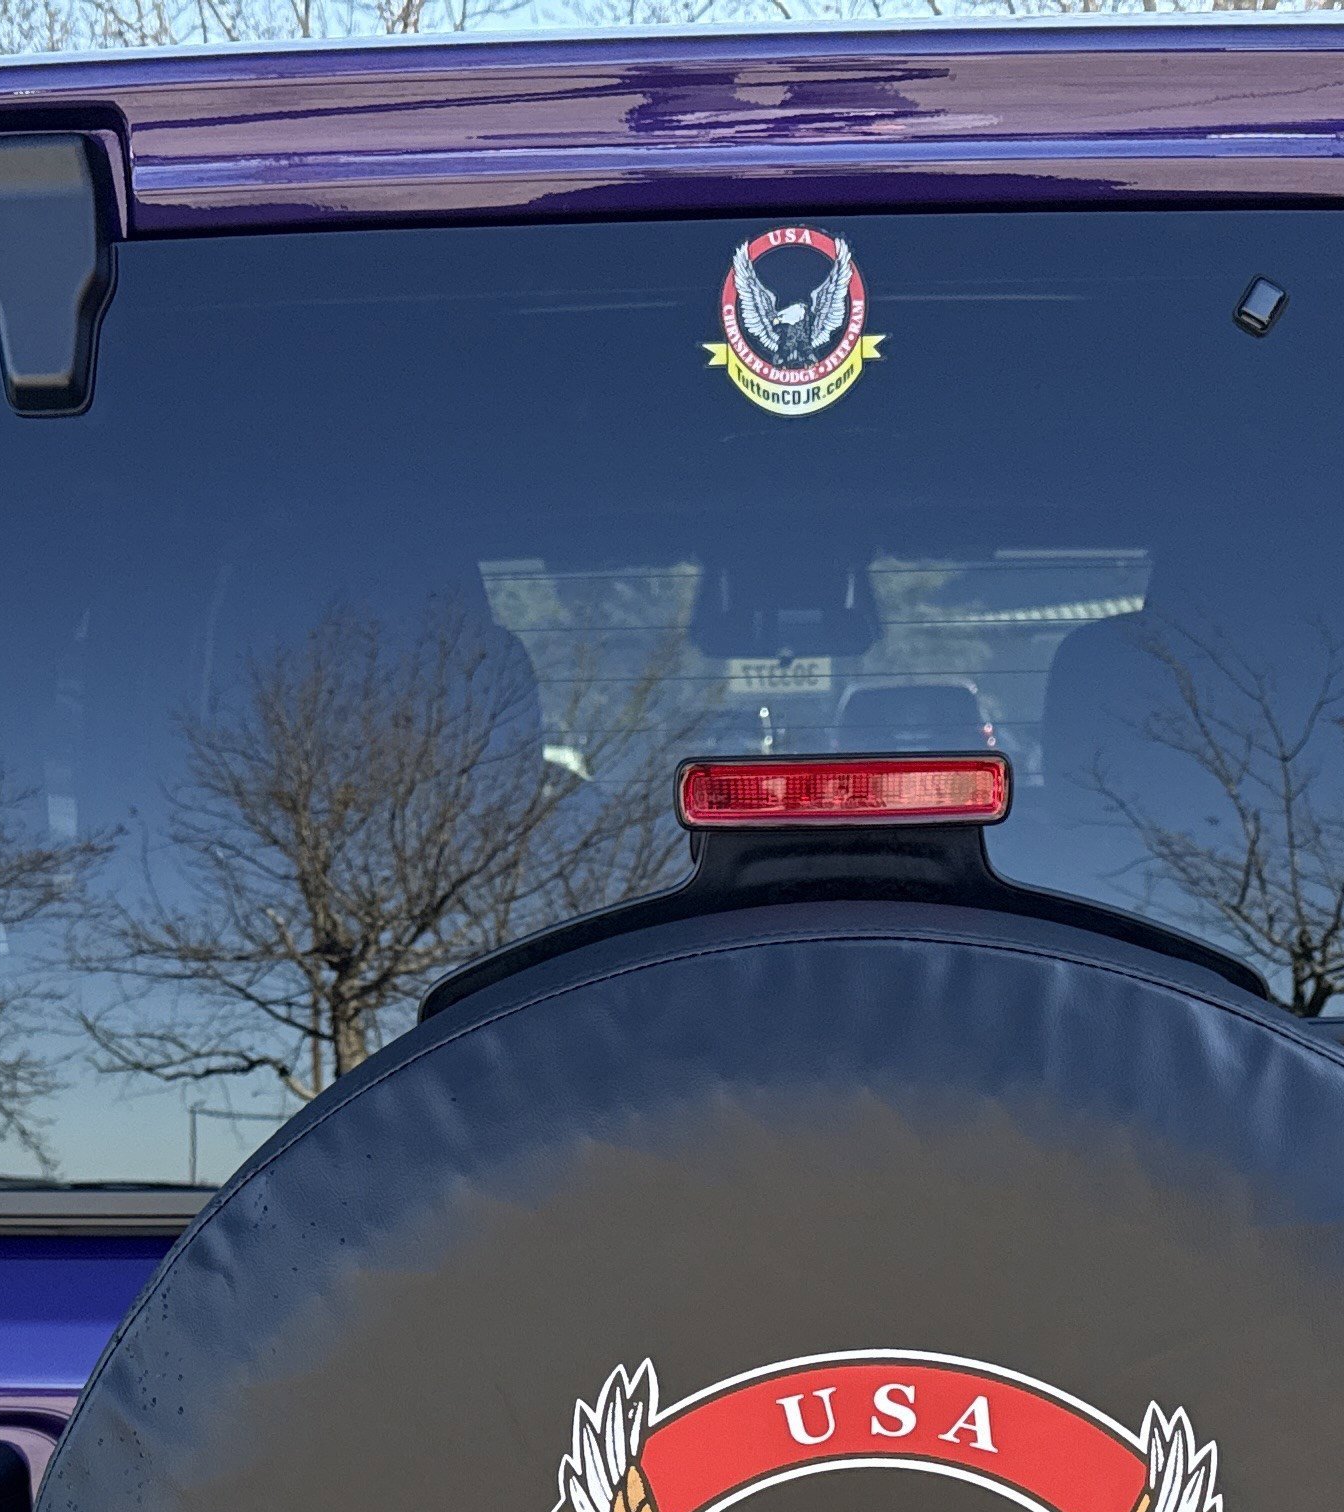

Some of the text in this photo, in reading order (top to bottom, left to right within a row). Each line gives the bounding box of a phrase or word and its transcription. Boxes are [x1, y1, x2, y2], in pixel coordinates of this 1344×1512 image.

[766, 227, 813, 245] USA
[722, 299, 865, 383] CHRYSLER DODGE JEEP RAM
[735, 363, 855, 406] TuttonCDJR.com
[776, 1383, 999, 1453] USA
